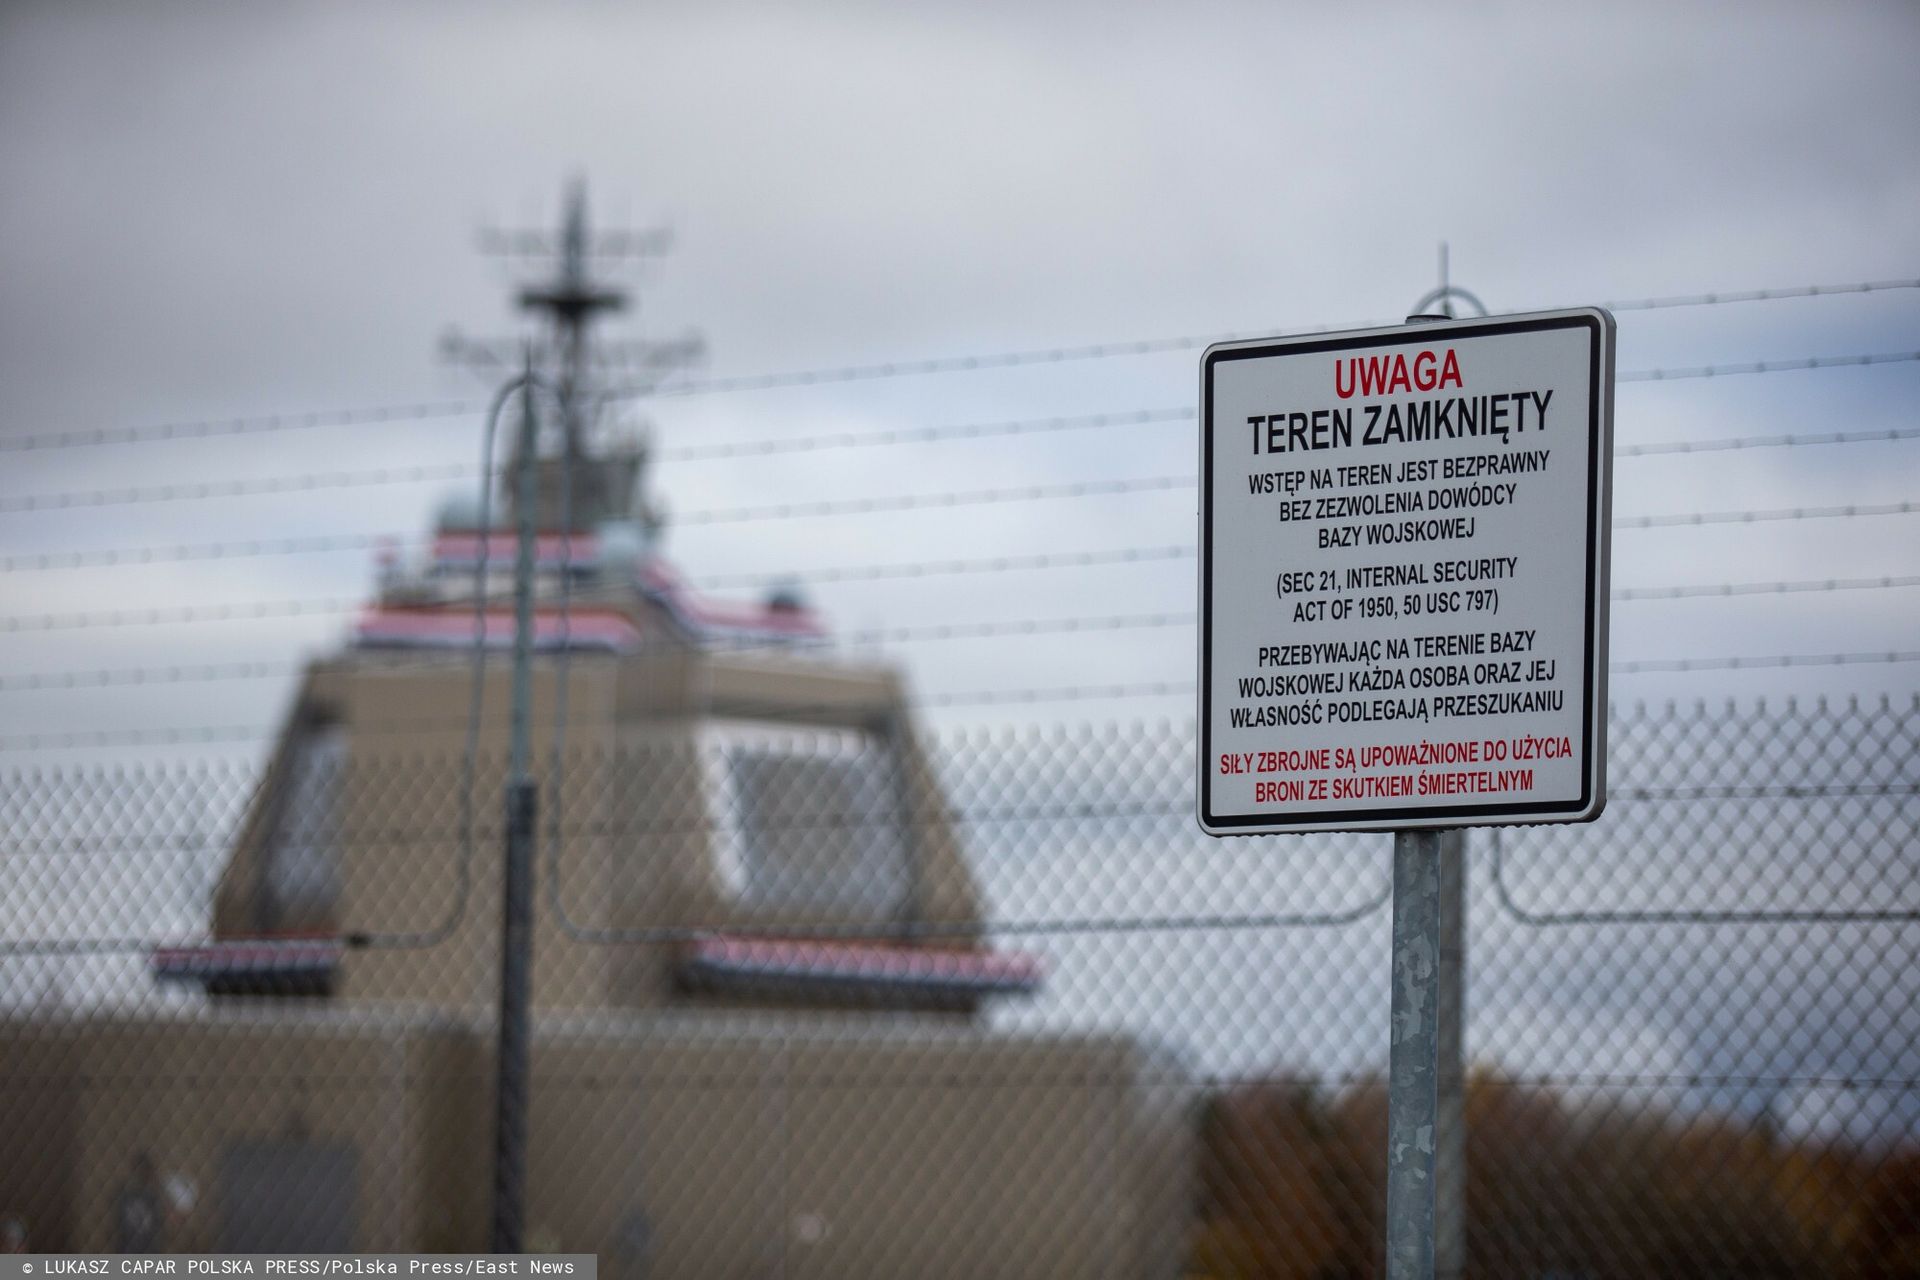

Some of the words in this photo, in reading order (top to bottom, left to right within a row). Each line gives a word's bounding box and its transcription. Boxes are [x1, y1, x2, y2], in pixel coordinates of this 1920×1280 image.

[1335, 349, 1463, 399] UWAGA
[1247, 408, 1352, 455] TEREN
[1362, 390, 1553, 446] ZAMKNIĘTY
[1249, 470, 1304, 496] WSTĘP
[1310, 468, 1333, 490] NA
[1337, 463, 1392, 488] TEREN
[1397, 459, 1438, 483] JEST
[1444, 450, 1550, 480] BEZPRAWNY
[1280, 498, 1311, 521] BEZ
[1316, 490, 1423, 519] ZEZWOLENIA
[1429, 483, 1517, 510] DOWÓDCY
[1319, 526, 1362, 549] BAZY
[1366, 517, 1475, 545] WOJSKOWEJ
[1277, 572, 1314, 599] (SEC
[1319, 570, 1342, 594] 21,
[1346, 563, 1429, 589] INTERNAL
[1433, 557, 1518, 585] SECURITY
[1293, 600, 1327, 623] ACT
[1332, 598, 1353, 620] OF
[1358, 595, 1399, 620] 1950,
[1403, 594, 1421, 615] 50
[1426, 591, 1461, 614] USC
[1466, 589, 1499, 615] 797)
[1259, 640, 1381, 668] PRZEBYWAJĄC
[1386, 637, 1409, 660] NA
[1414, 633, 1485, 658] TERENIE
[1490, 630, 1535, 653] BAZY
[1239, 671, 1344, 698] WOJSKOWEJ
[1349, 665, 1405, 693] KAŻDA
[1410, 665, 1469, 689] OSOBA
[1474, 662, 1521, 685] ORAZ
[1525, 659, 1555, 682] JEJ
[1231, 700, 1322, 729] WŁASNOŚĆ
[1328, 697, 1429, 723] PODLEGAJĄ
[1434, 690, 1563, 717] PRZESZUKANIU
[1221, 751, 1252, 775] SIŁY
[1257, 747, 1330, 773] ZBROJNE
[1335, 747, 1356, 773] SĄ
[1361, 739, 1478, 767] UPOWAŻNIONE
[1484, 740, 1507, 761] DO
[1512, 734, 1572, 760] UŻYCIA
[1255, 779, 1304, 803] BRONI
[1308, 779, 1328, 800] ZE
[1333, 775, 1413, 799] SKUTKIEM
[1418, 769, 1533, 796] ŚMIERTELNYM
